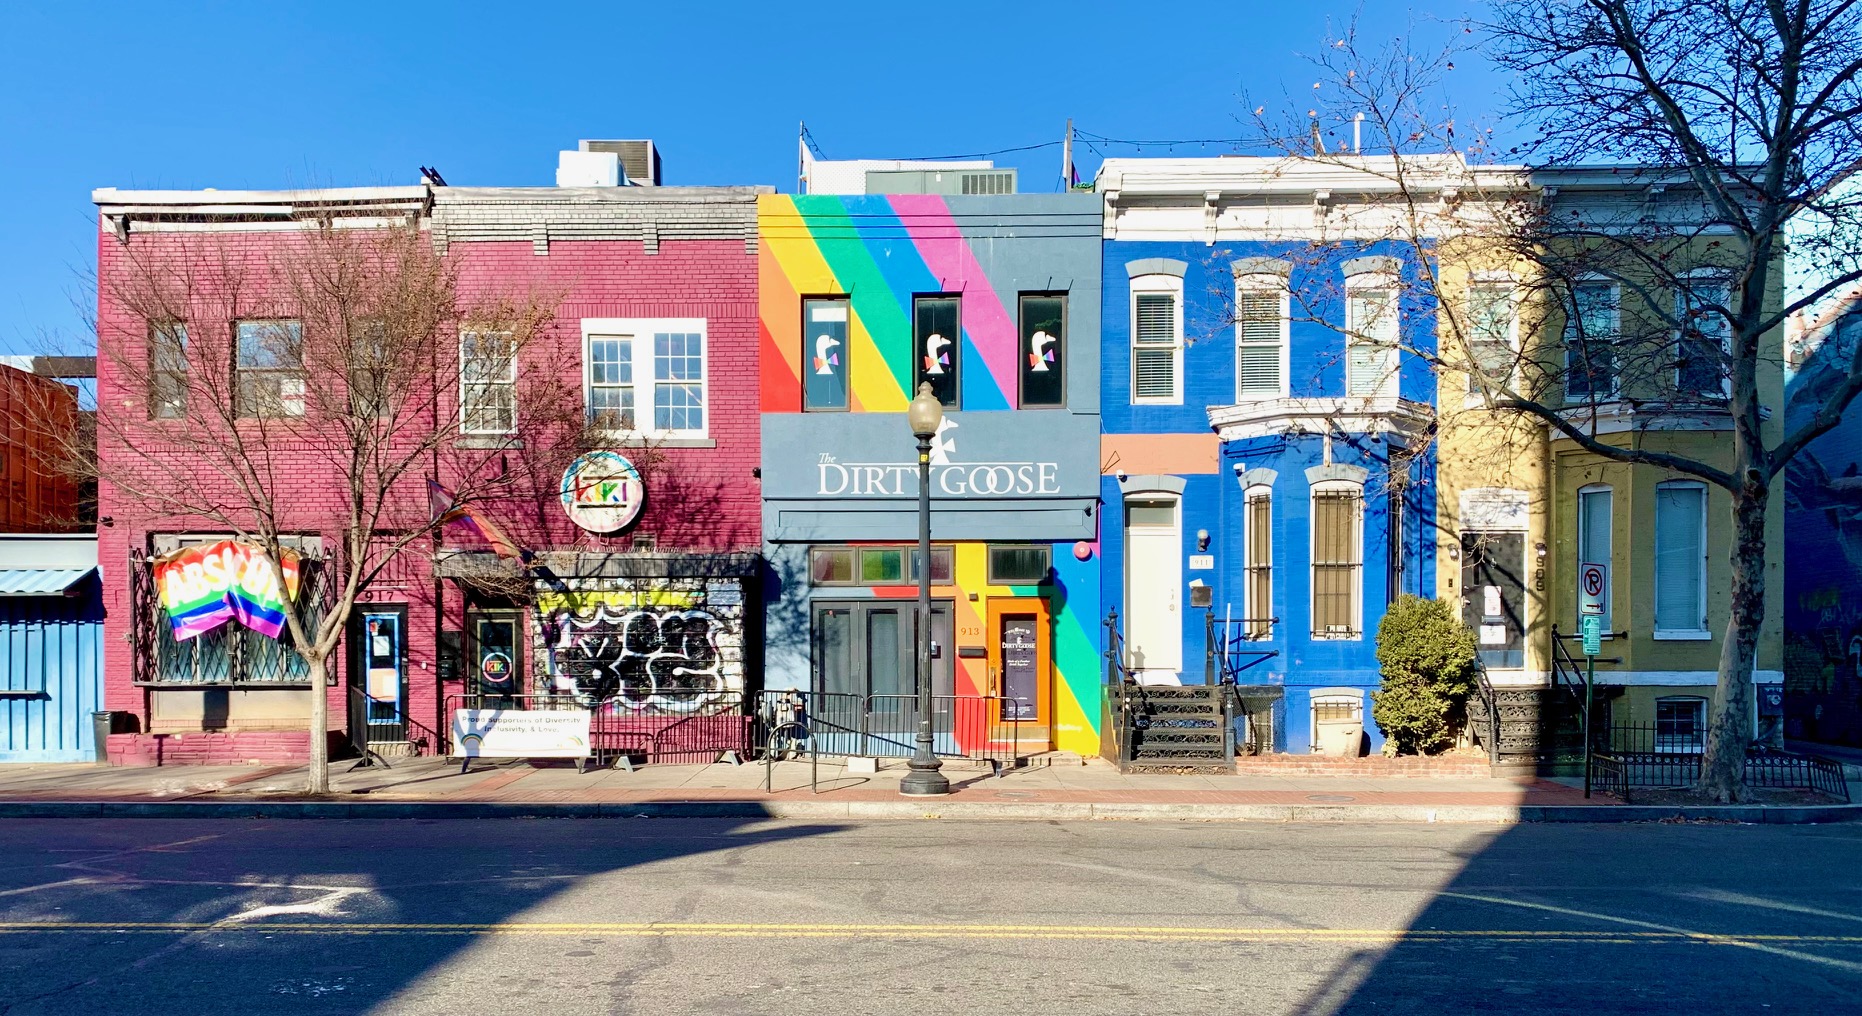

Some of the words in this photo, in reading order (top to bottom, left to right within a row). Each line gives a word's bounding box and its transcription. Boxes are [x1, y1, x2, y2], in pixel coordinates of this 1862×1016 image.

[818, 452, 837, 464] The
[940, 462, 1060, 495] GOOSE
[574, 475, 627, 502] KIKI
[365, 591, 394, 602] 917
[960, 627, 980, 636] 913
